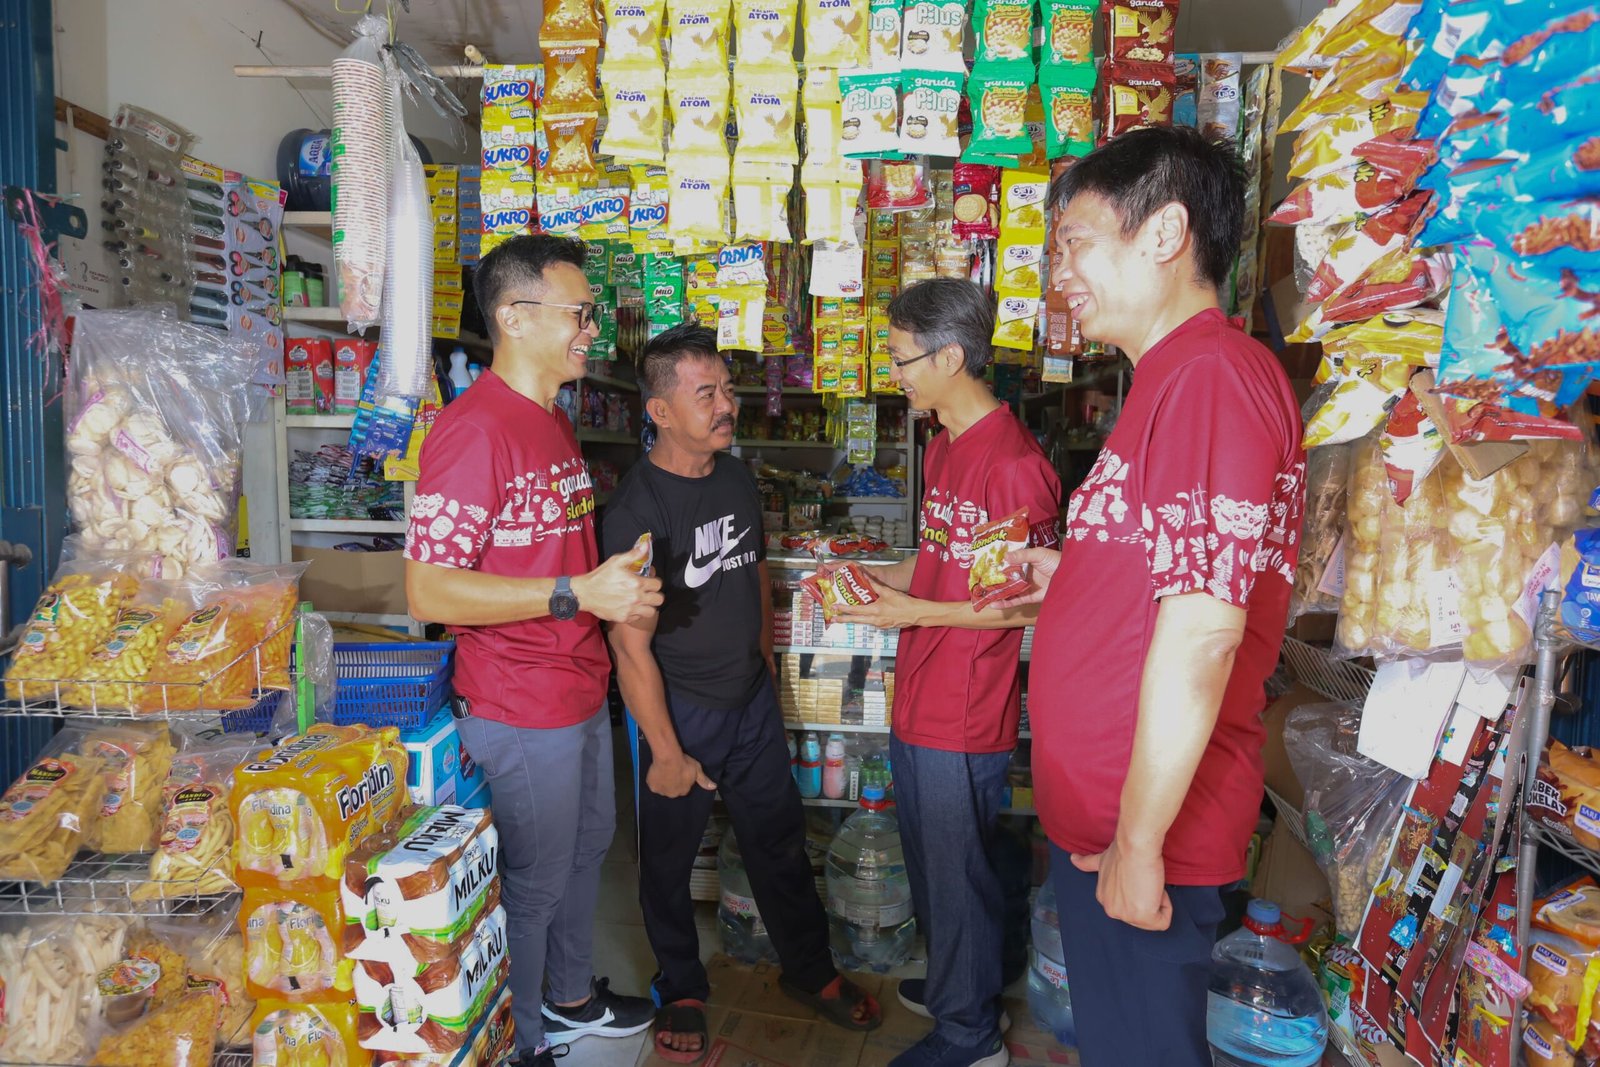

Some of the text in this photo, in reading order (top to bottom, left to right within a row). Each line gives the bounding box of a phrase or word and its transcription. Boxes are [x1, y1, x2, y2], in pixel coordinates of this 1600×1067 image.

[615, 9, 645, 17] ATOM
[819, 0, 850, 8] ATOM
[679, 16, 709, 25] ATOM
[748, 12, 779, 21] ATOM
[869, 15, 895, 31] lus
[917, 4, 961, 26] Pilus
[550, 47, 586, 57] garuda
[485, 81, 529, 101] SUKRO
[914, 77, 956, 87] garuda
[1128, 78, 1162, 86] garuda
[615, 94, 646, 102] ATOM
[750, 97, 781, 106] ATOM
[848, 89, 892, 111] Pilus
[915, 91, 958, 112] Pilus
[550, 119, 585, 131] garuda
[308, 139, 323, 164] AQUA
[484, 146, 529, 166] SUKRO
[680, 182, 710, 190] ATOM
[582, 197, 624, 221] SUKRO
[629, 205, 665, 225] UKRO
[484, 209, 529, 229] SUKRO
[616, 256, 634, 264] MILO
[719, 243, 763, 265] SUKRO
[655, 288, 672, 296] MILO
[843, 333, 858, 341] AMH
[842, 370, 858, 378] AMH
[930, 501, 954, 526] ruda
[694, 514, 735, 560] NIKE
[722, 554, 744, 572] JUST
[839, 565, 871, 604] garuda
[1531, 779, 1560, 799] OBEK
[1527, 794, 1567, 816] OKELAT
[403, 811, 466, 852] MILKU
[455, 847, 494, 912] MILKU
[466, 927, 502, 997] MILKU
[1043, 964, 1068, 982] inerale
